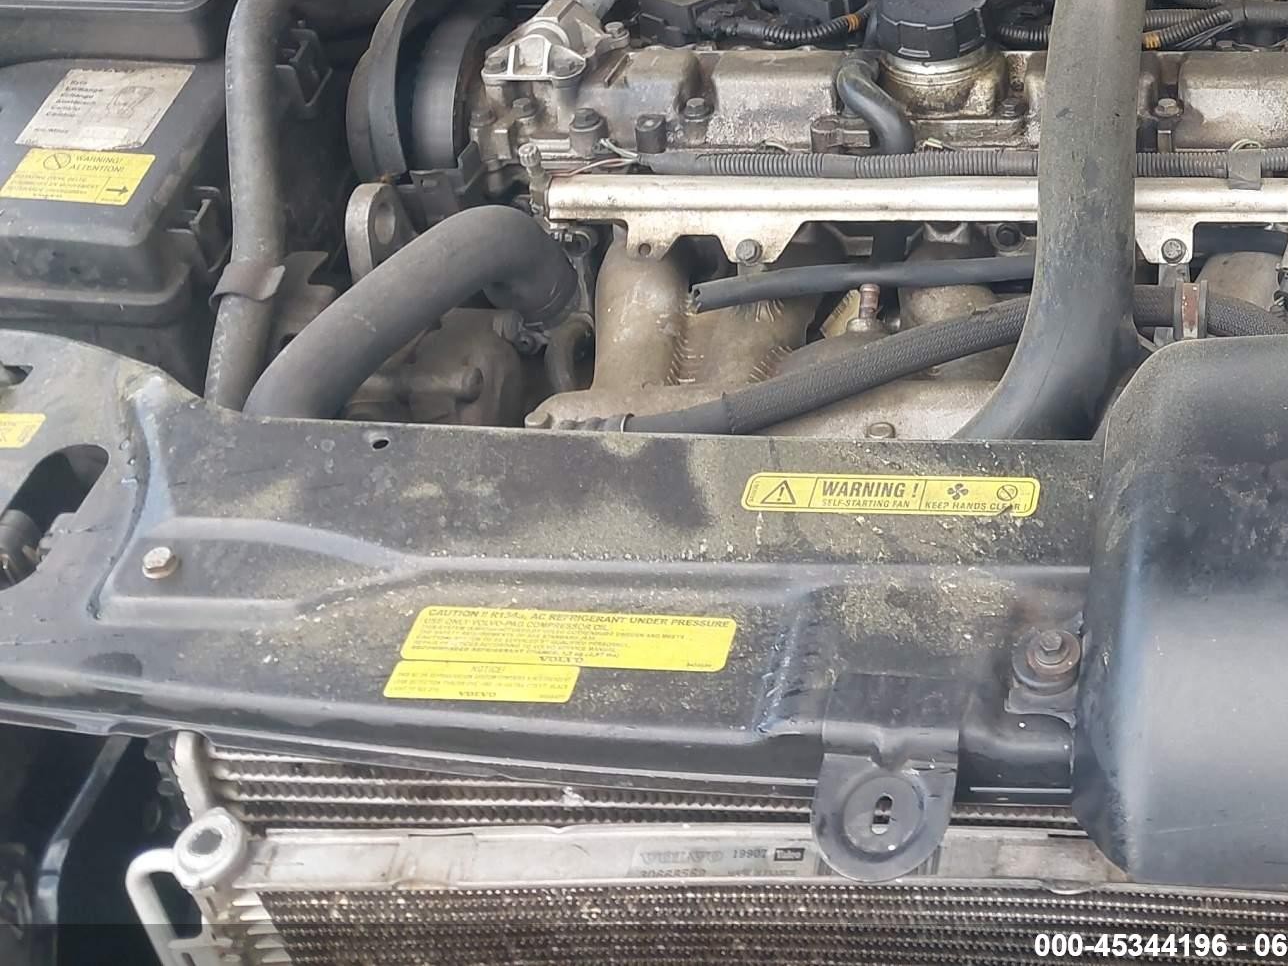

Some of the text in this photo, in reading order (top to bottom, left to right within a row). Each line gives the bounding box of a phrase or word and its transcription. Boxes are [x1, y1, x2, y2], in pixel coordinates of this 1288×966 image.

[822, 481, 906, 498] WARNING
[822, 498, 911, 508] SELF-STARTING FAN
[925, 501, 949, 510] KEEP
[952, 502, 987, 511] HANDS
[428, 609, 479, 617] CAUTION
[549, 613, 627, 623] REFRIGERANT
[630, 617, 669, 625] UNDER
[671, 619, 730, 627] PRESSURE
[539, 656, 584, 664] VOLVO
[459, 690, 497, 698] VOLVO
